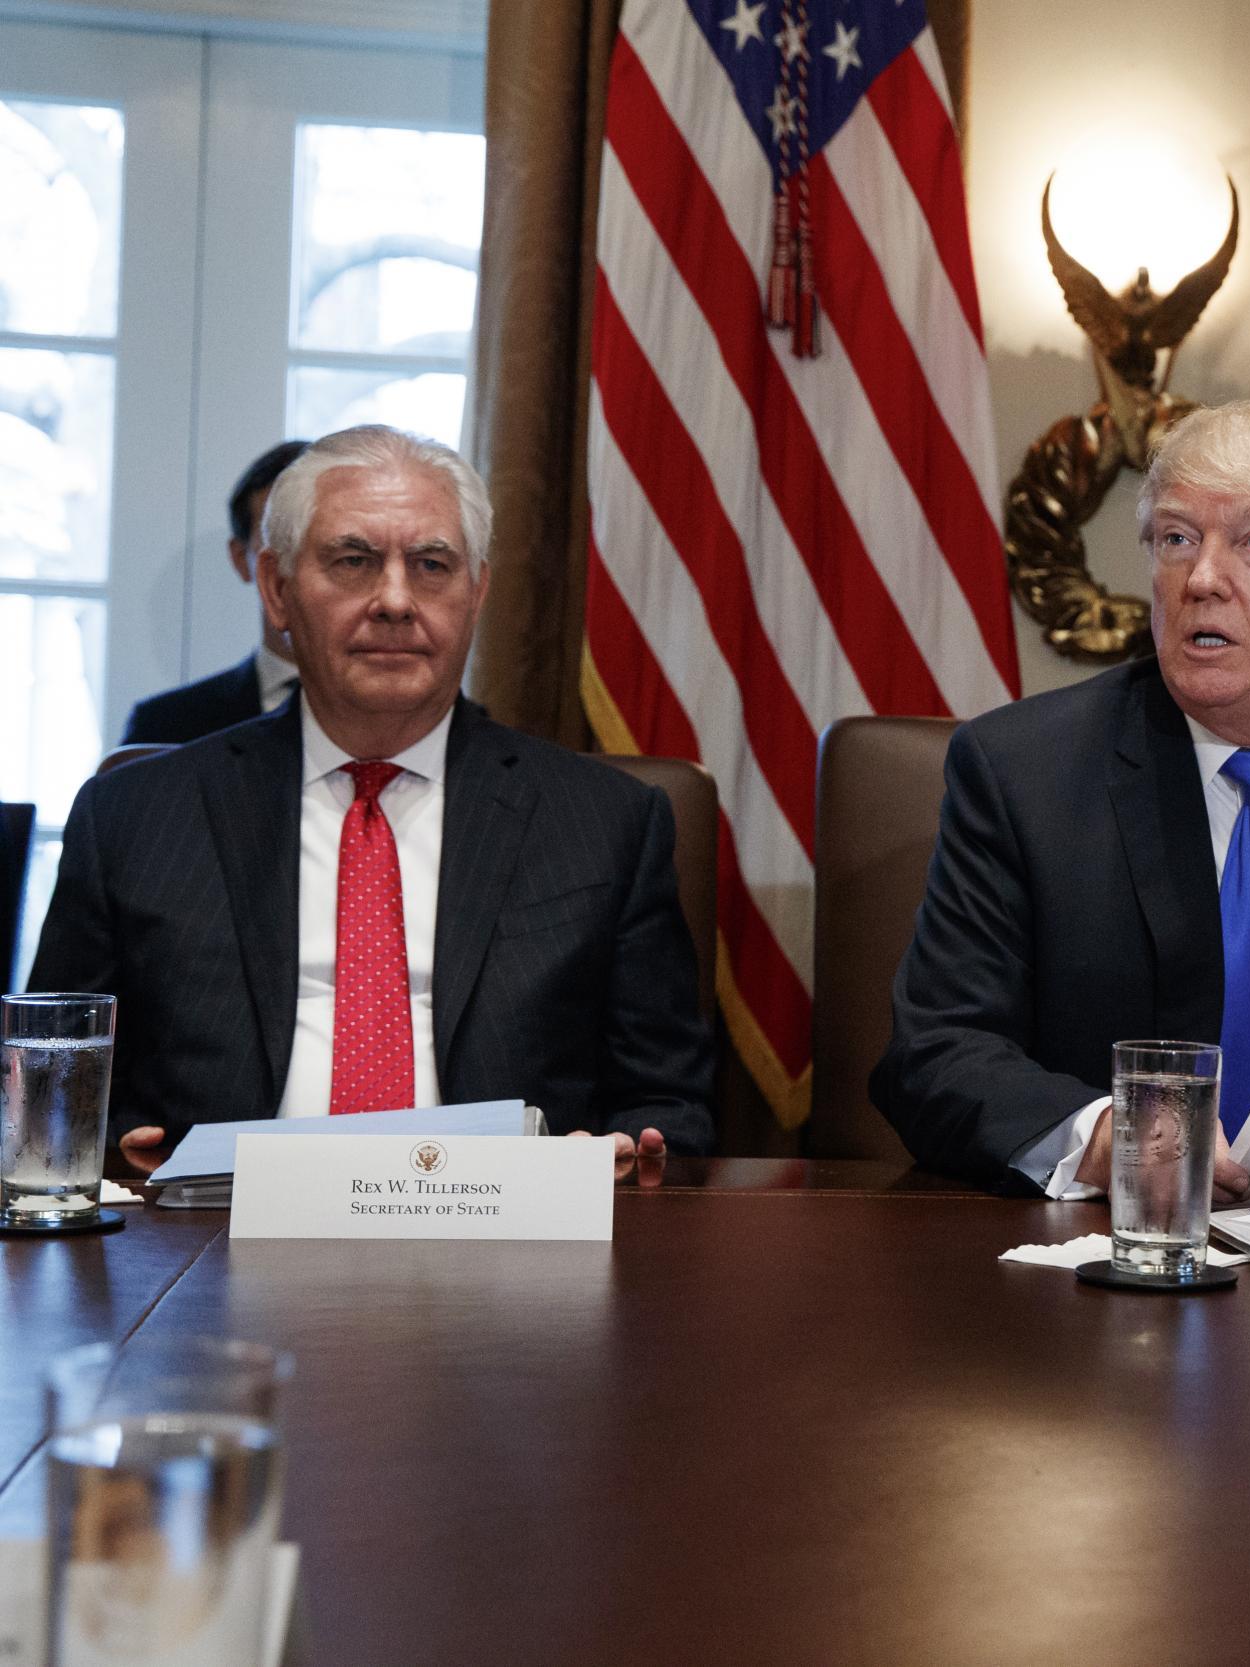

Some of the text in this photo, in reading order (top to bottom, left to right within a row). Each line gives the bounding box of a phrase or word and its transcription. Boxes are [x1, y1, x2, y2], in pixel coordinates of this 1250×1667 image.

[351, 1179, 502, 1195] REX W. TILLERSON
[350, 1201, 500, 1216] SECRETARY OF STATE
